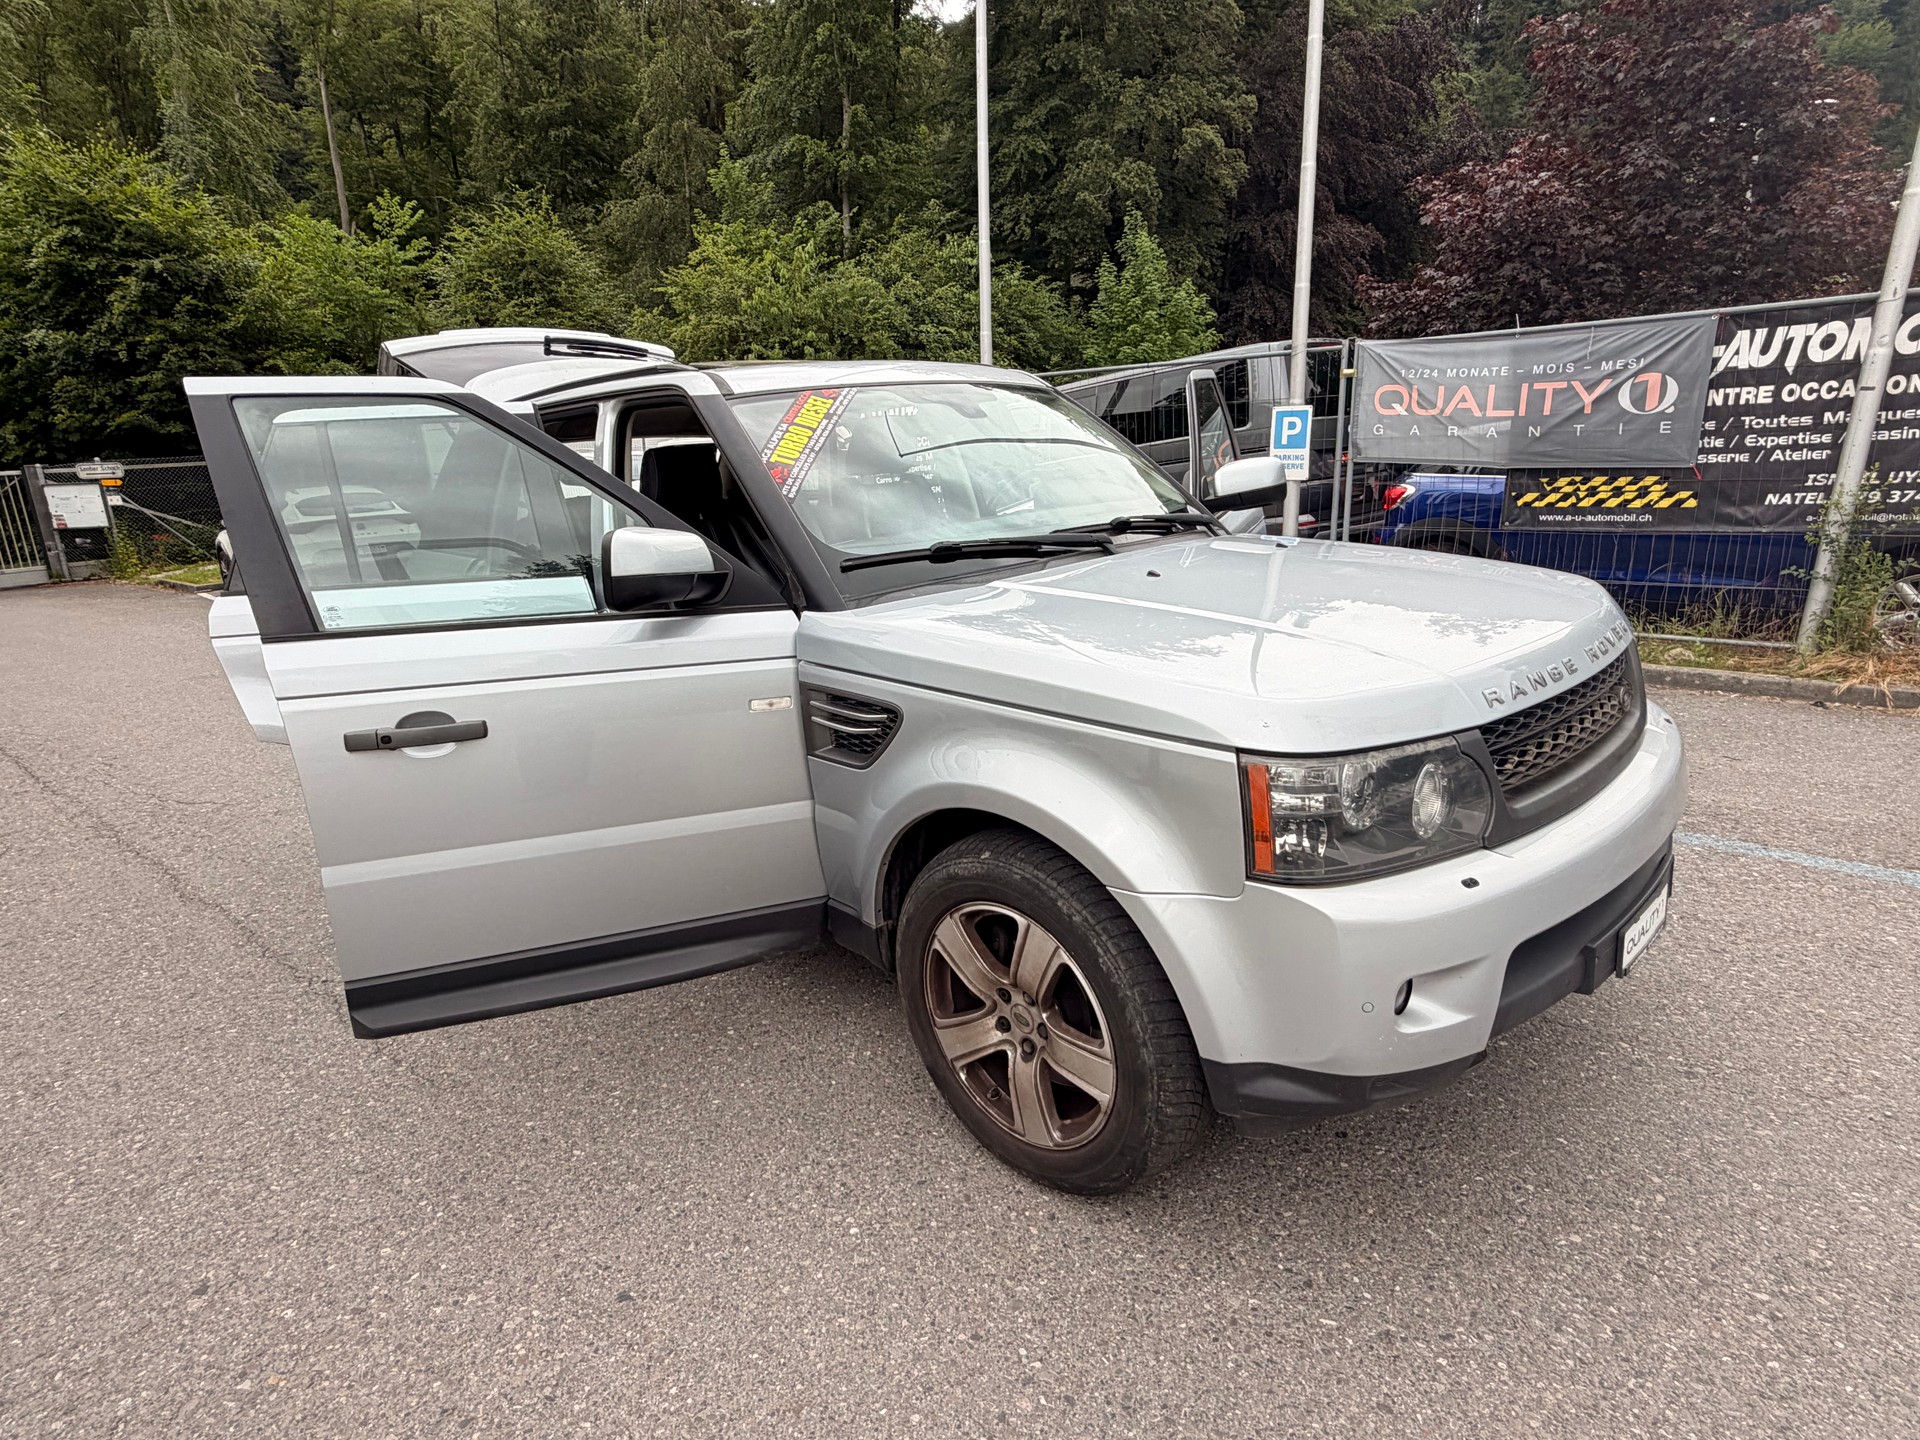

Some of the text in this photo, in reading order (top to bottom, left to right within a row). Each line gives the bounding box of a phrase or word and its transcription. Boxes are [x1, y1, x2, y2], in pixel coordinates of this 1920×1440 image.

[1400, 368, 1438, 378] 12/24
[1446, 366, 1509, 378] MONATE
[1532, 362, 1575, 375] MOIS
[1601, 358, 1644, 371] MESI
[1374, 378, 1613, 417] QUALITY
[1281, 416, 1302, 445] P
[1373, 421, 1672, 438] GARANTIE
[1741, 414, 1813, 429] Toutes
[769, 425, 814, 465] TURBO
[1744, 431, 1832, 449] Expertise
[1770, 449, 1831, 462] Atelier
[1538, 513, 1653, 522] www.a-u-automobil.ch
[1482, 656, 1579, 709] RANGE
[1584, 619, 1628, 663] ROVER
[1626, 907, 1659, 955] QUALITY
